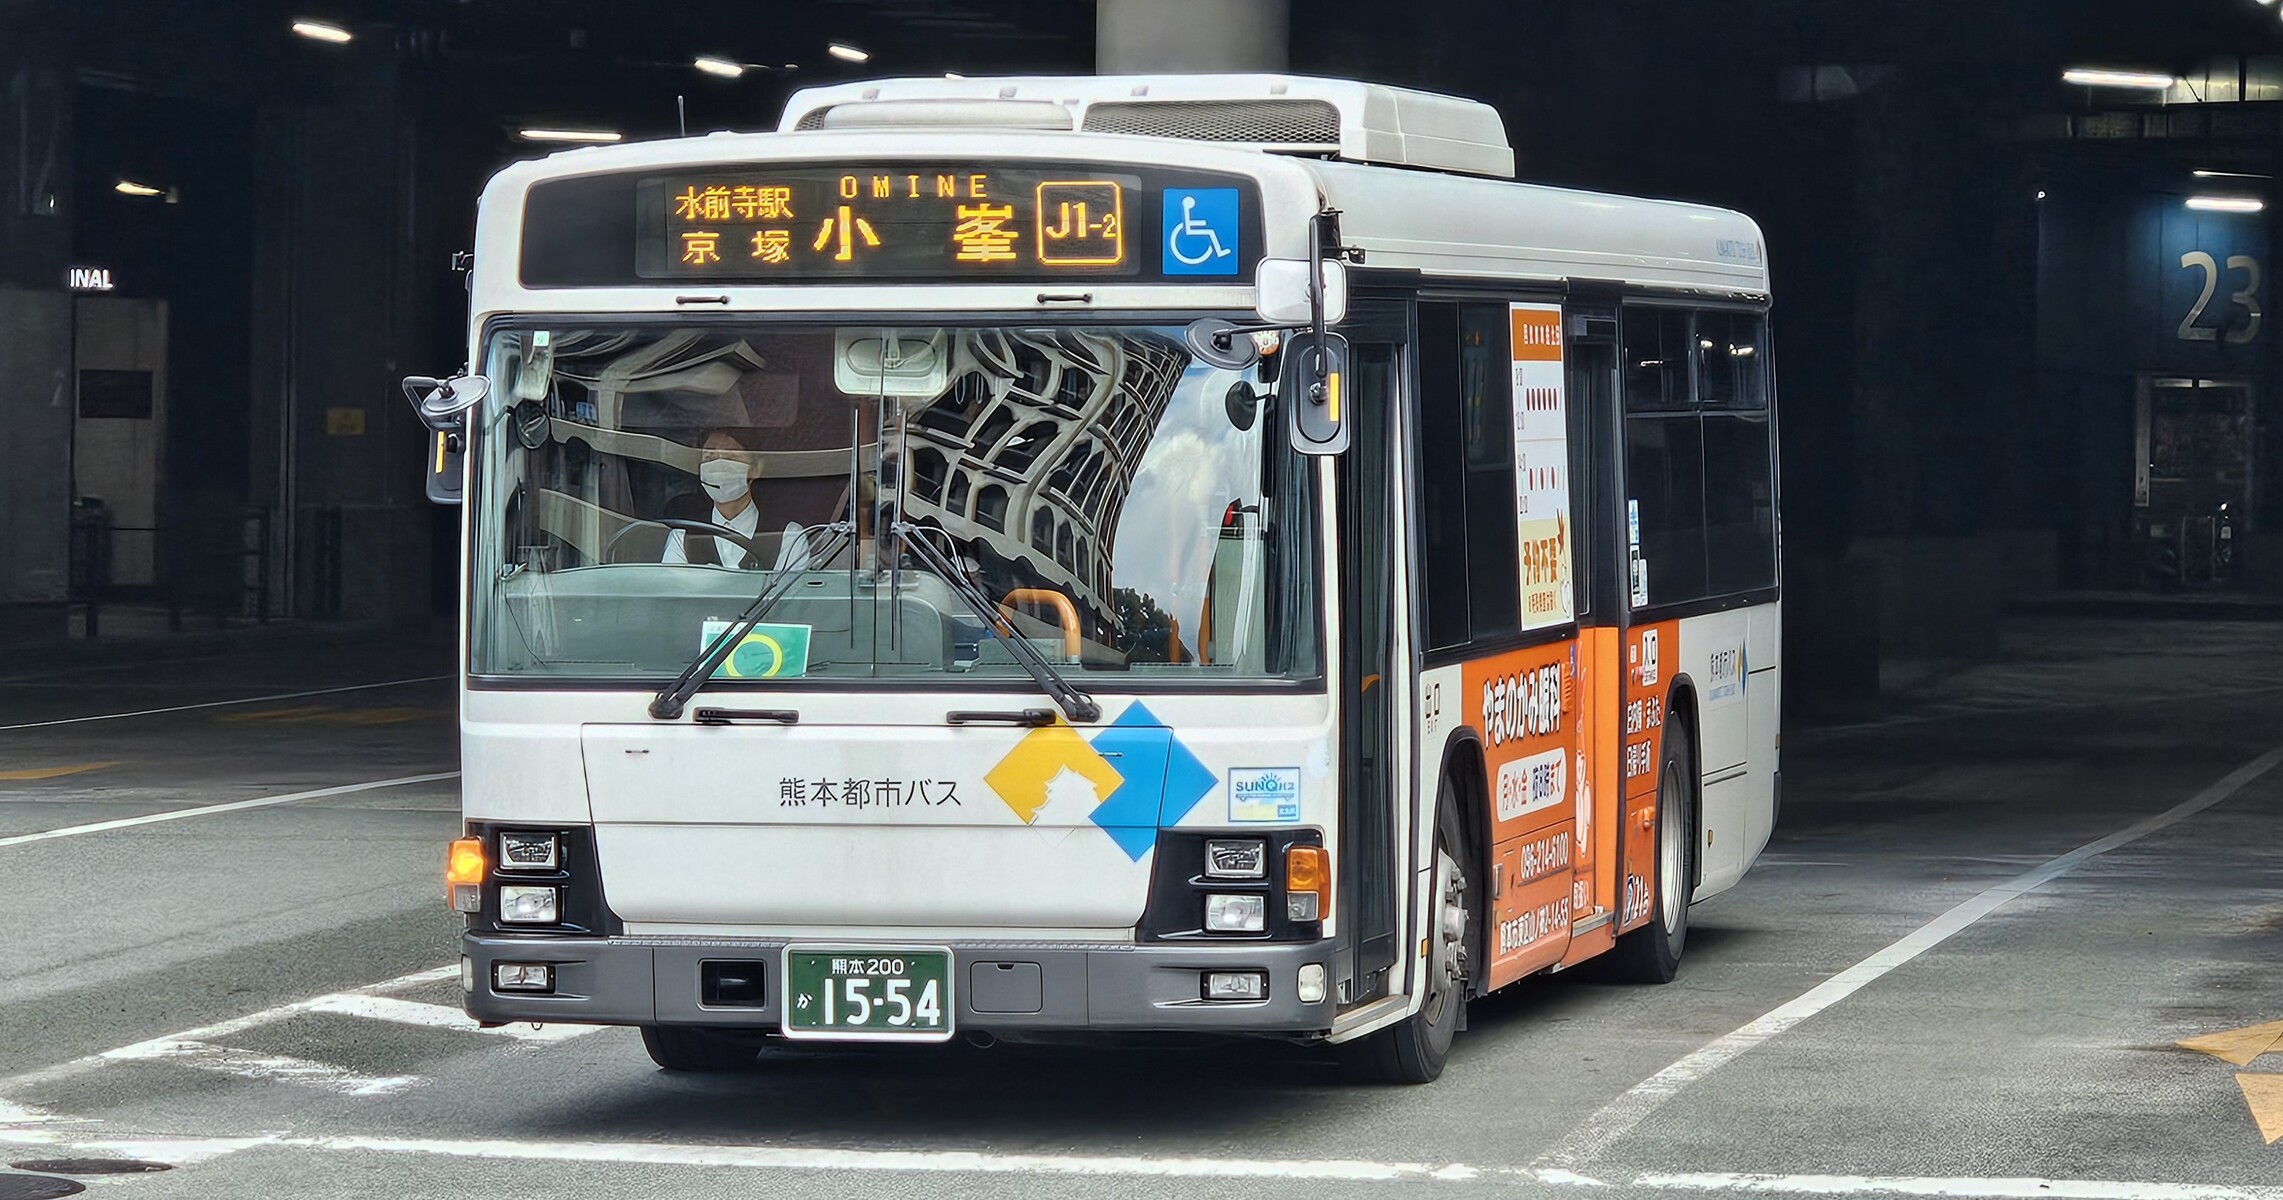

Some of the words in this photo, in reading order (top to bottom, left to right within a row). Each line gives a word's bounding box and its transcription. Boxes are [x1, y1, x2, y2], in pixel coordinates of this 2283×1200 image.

[675, 186, 794, 220] 水前寺駅
[840, 174, 988, 198] OMINE
[1045, 201, 1117, 239] J1-2
[70, 268, 114, 288] INAL
[2178, 250, 2262, 344] 23
[1644, 635, 1656, 666] 入口
[1425, 683, 1440, 719] 出口
[1482, 661, 1561, 750] やまのかみ眼科
[780, 777, 962, 810] 熊本都市バス
[797, 993, 813, 1009] か
[824, 978, 941, 1026] 15-54
